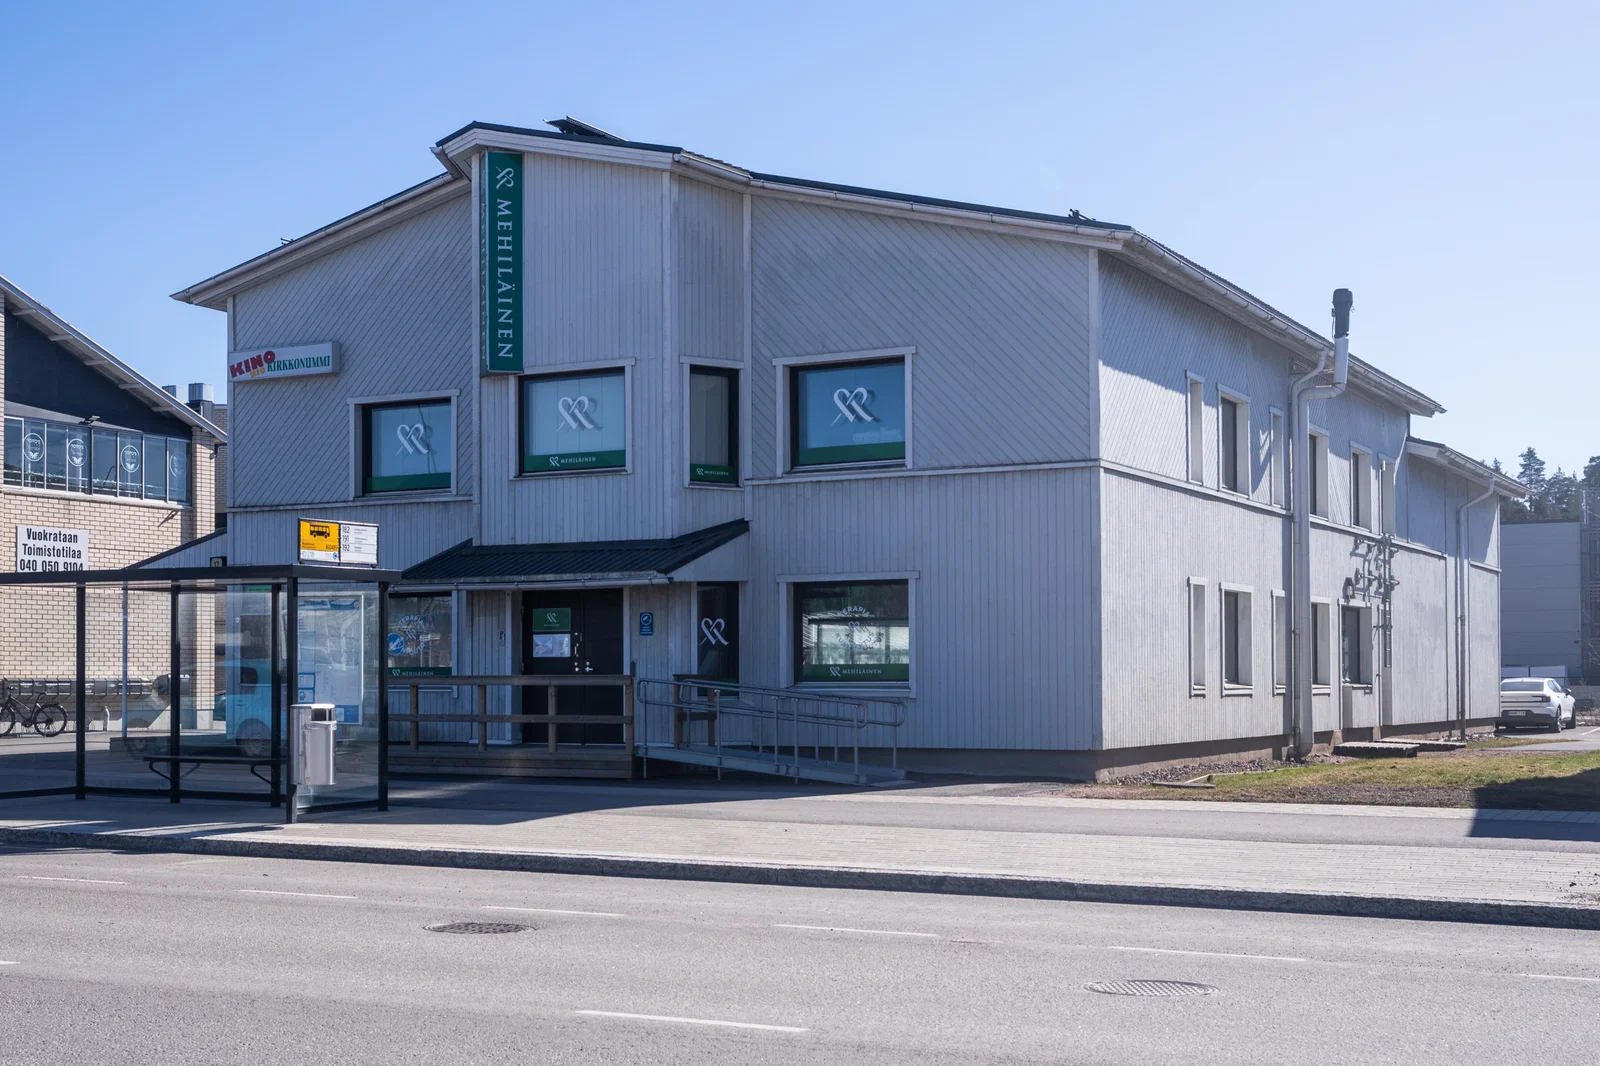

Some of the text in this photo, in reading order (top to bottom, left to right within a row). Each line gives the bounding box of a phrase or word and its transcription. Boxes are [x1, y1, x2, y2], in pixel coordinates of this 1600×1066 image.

[496, 199, 515, 358] MEHILÄINEN
[229, 350, 276, 378] KINO
[267, 355, 331, 372] KIRKKONUMMI
[560, 456, 597, 464] MEHILÄINEN
[26, 527, 78, 544] Vuokrataan
[342, 526, 351, 534] 182
[342, 535, 350, 543] 191
[22, 543, 82, 559] Toimistotilaa
[342, 544, 351, 552] 192
[20, 559, 83, 572] 040 050 9104
[841, 605, 870, 617] TERAPIA
[398, 615, 424, 626] TERAPIA
